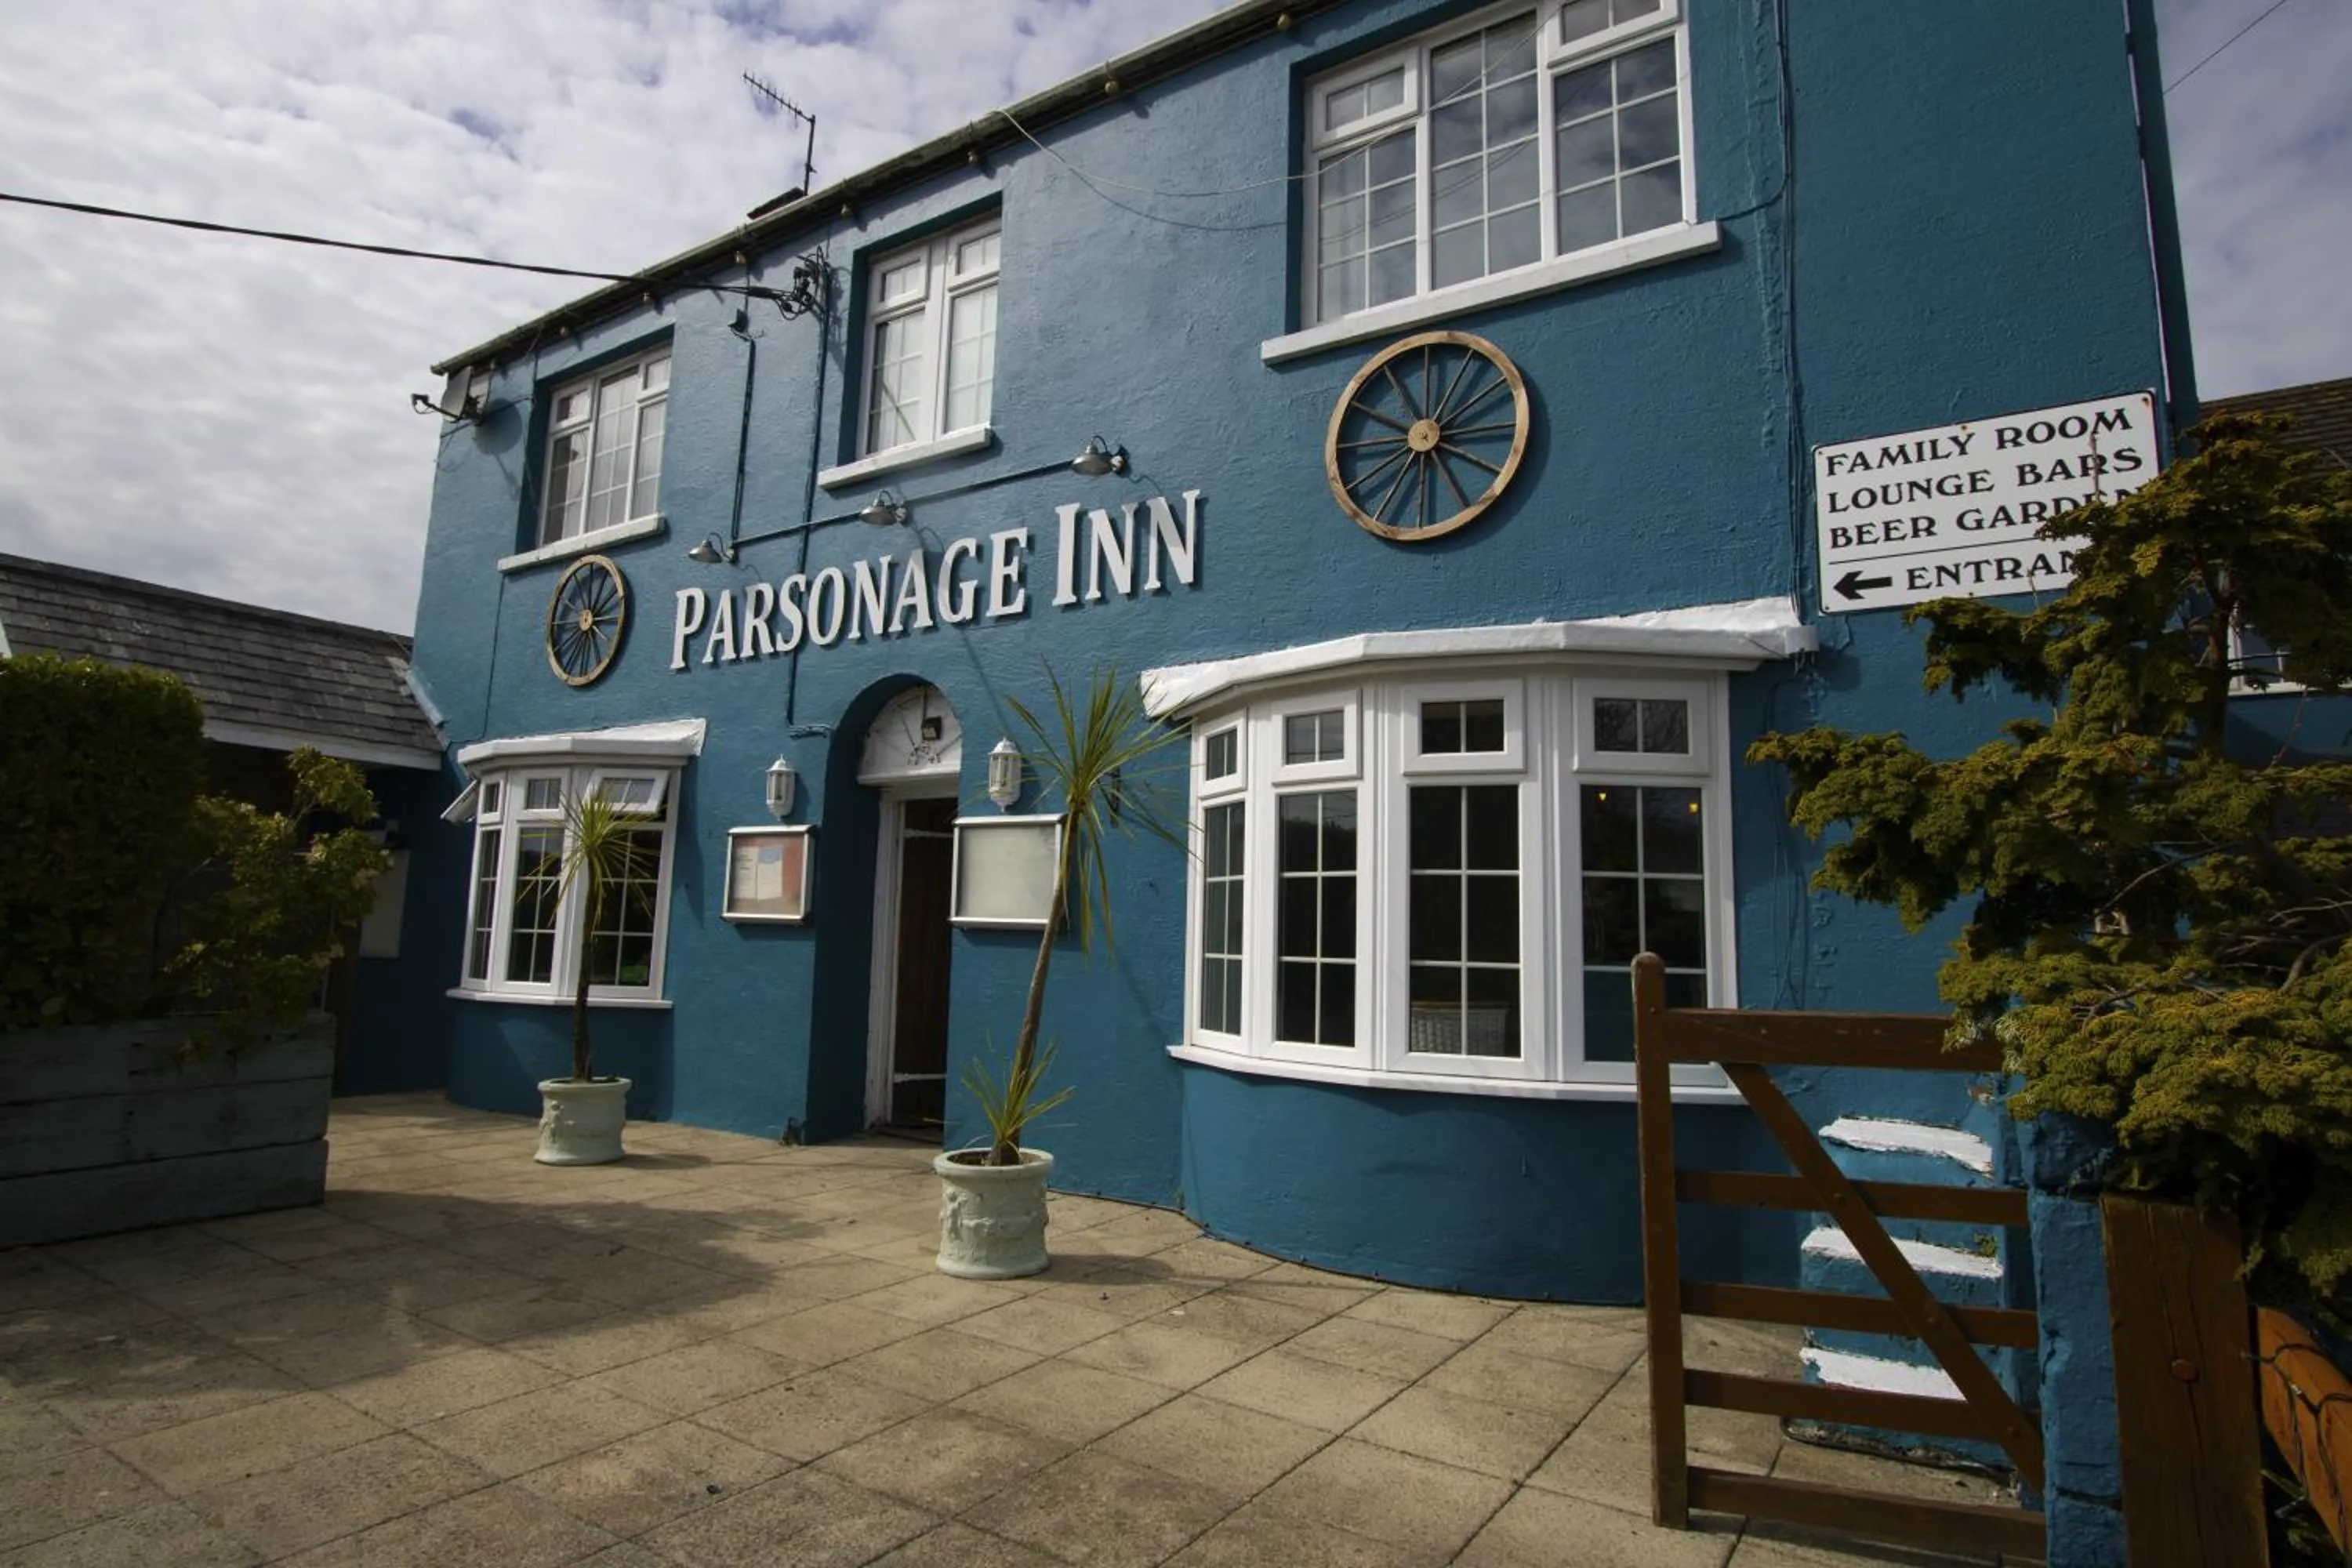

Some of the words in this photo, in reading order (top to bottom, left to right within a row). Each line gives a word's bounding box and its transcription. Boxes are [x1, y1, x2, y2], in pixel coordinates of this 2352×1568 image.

[1826, 432, 1975, 476] FAMILY
[1995, 408, 2132, 450] ROOM
[1828, 470, 1994, 514] LOUNGE
[2016, 448, 2143, 487] BARS
[1830, 517, 1937, 549] BEER
[670, 527, 1029, 670] PARSONAGE
[1052, 489, 1200, 607] INN
